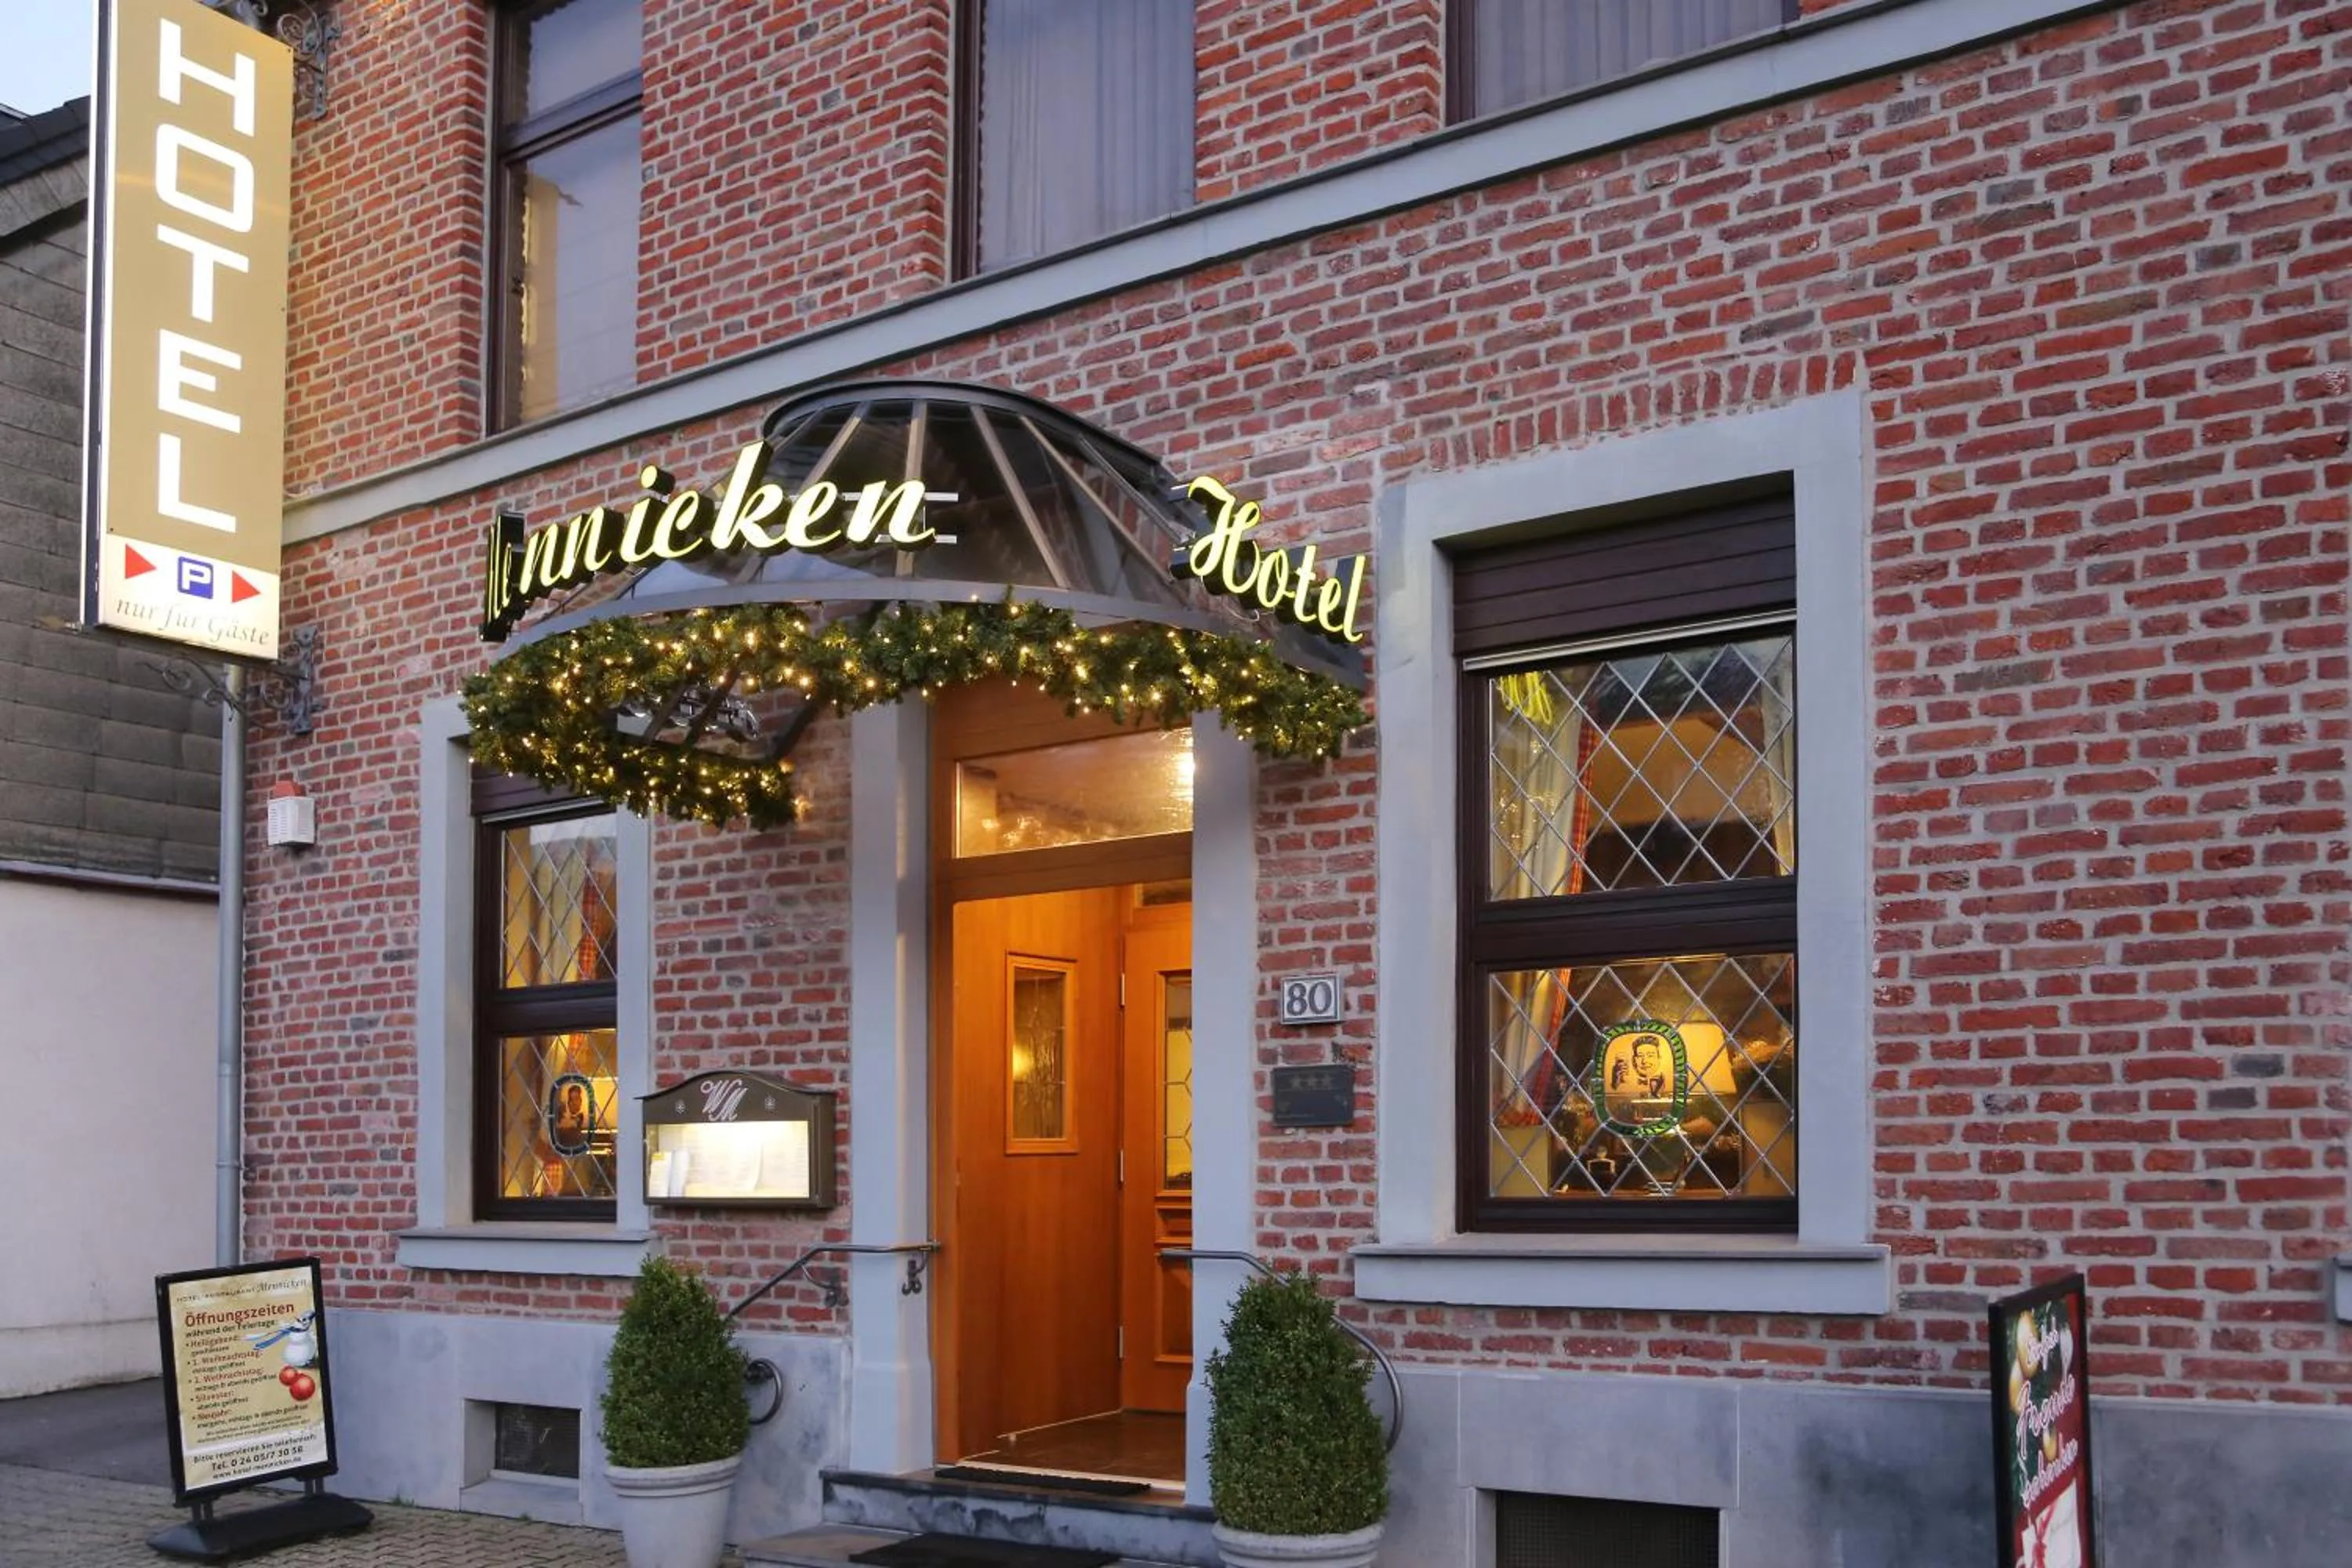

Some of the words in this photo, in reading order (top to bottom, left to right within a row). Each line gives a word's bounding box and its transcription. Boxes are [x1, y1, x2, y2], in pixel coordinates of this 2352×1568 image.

[156, 17, 255, 533] HOTEL
[1189, 476, 1365, 642] Hotel
[181, 560, 212, 593] P
[116, 598, 154, 619] nur
[208, 614, 270, 645] Gäste
[1287, 982, 1332, 1016] 80
[185, 1303, 295, 1327] Öffnungszeiten
[185, 1326, 220, 1338] während
